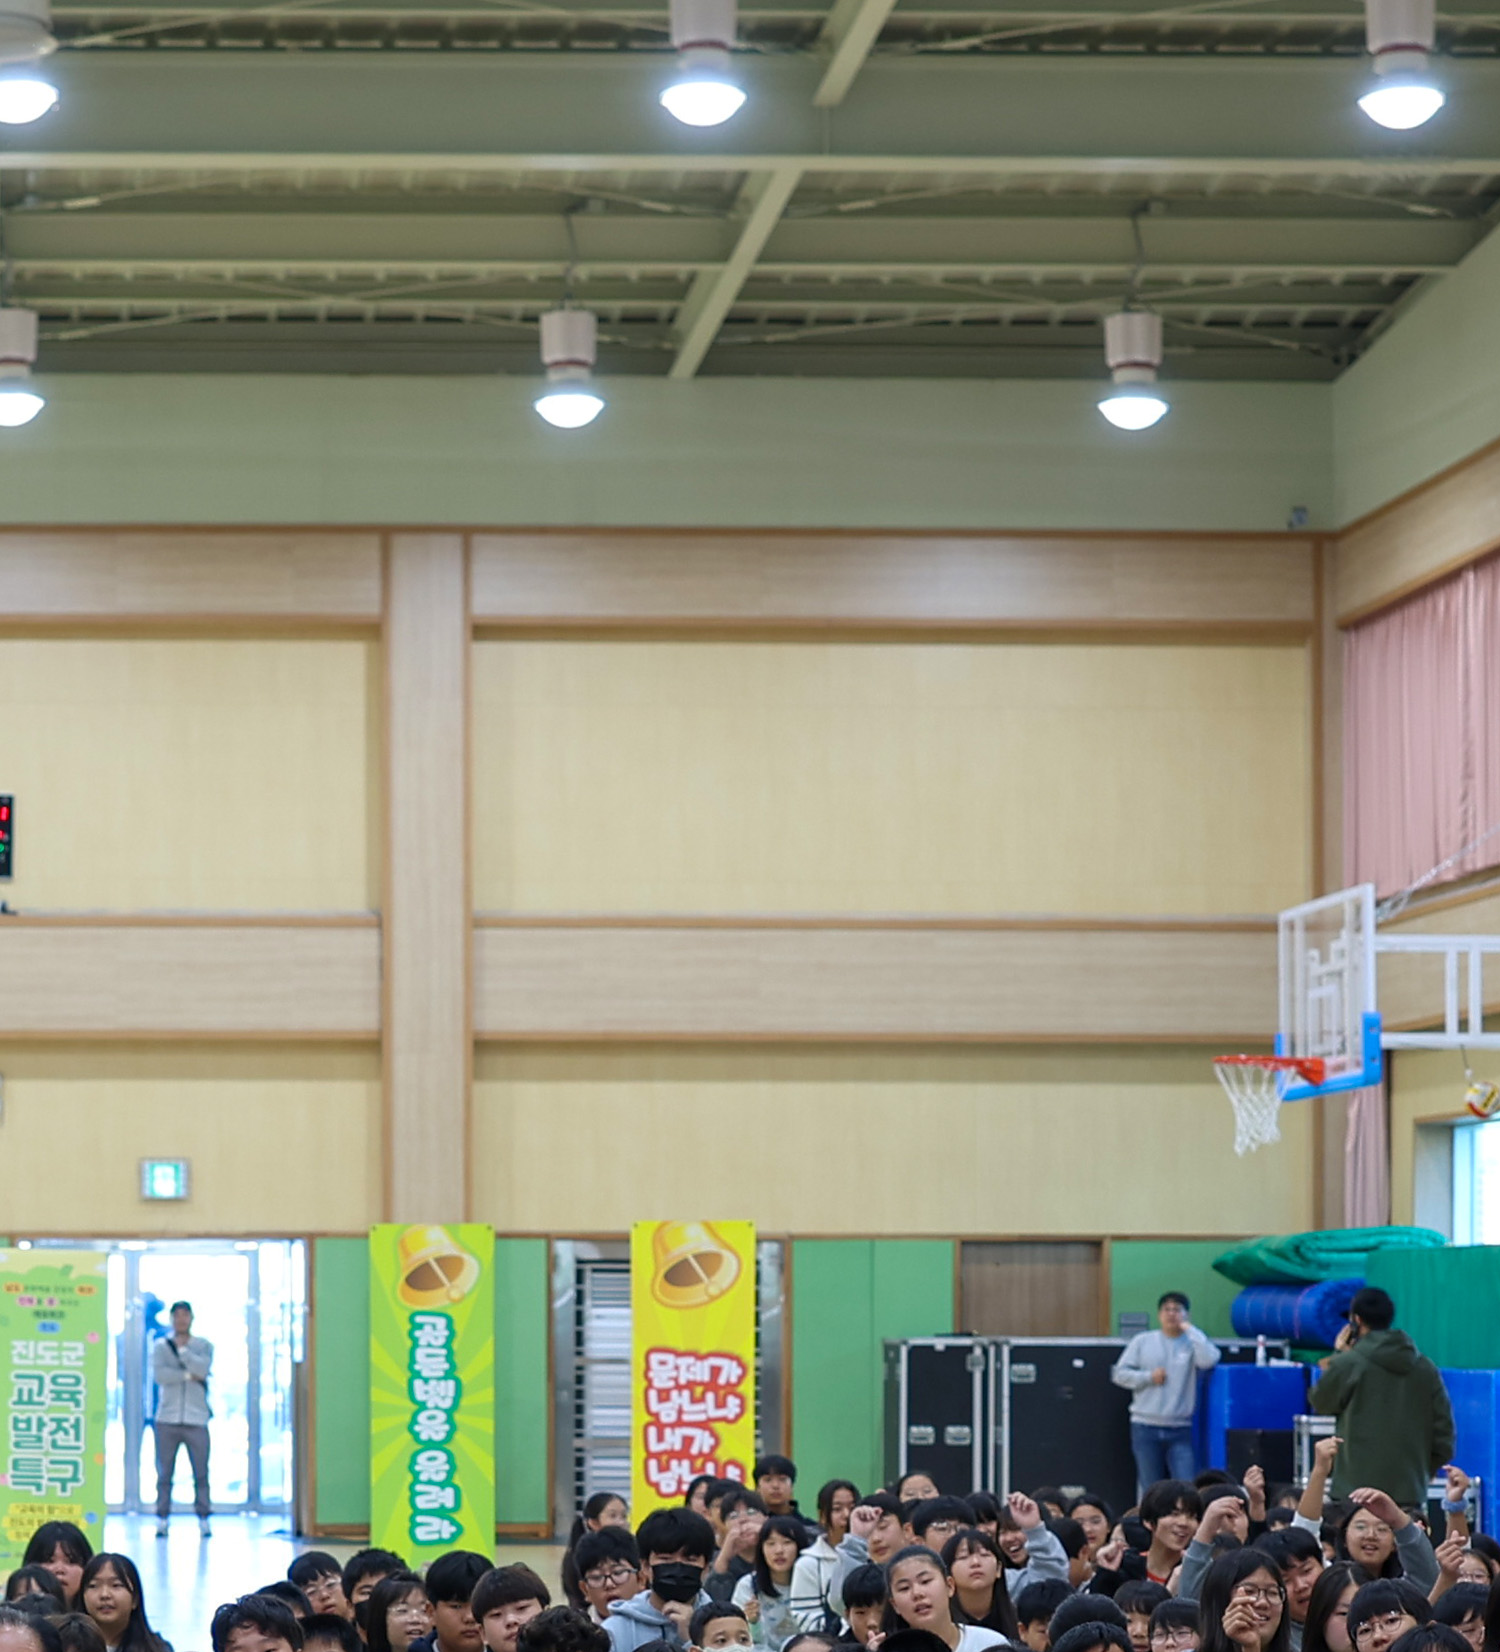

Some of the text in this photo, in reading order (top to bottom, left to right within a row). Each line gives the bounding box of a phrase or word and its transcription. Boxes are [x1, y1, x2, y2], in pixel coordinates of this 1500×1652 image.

[11, 1340, 85, 1367] 진도군
[648, 1352, 743, 1388] 문제가
[10, 1371, 84, 1411] 교육
[412, 1314, 457, 1442] 골든벨을
[9, 1412, 85, 1454] 발전
[646, 1425, 716, 1455] 내가
[8, 1454, 84, 1496] 특구
